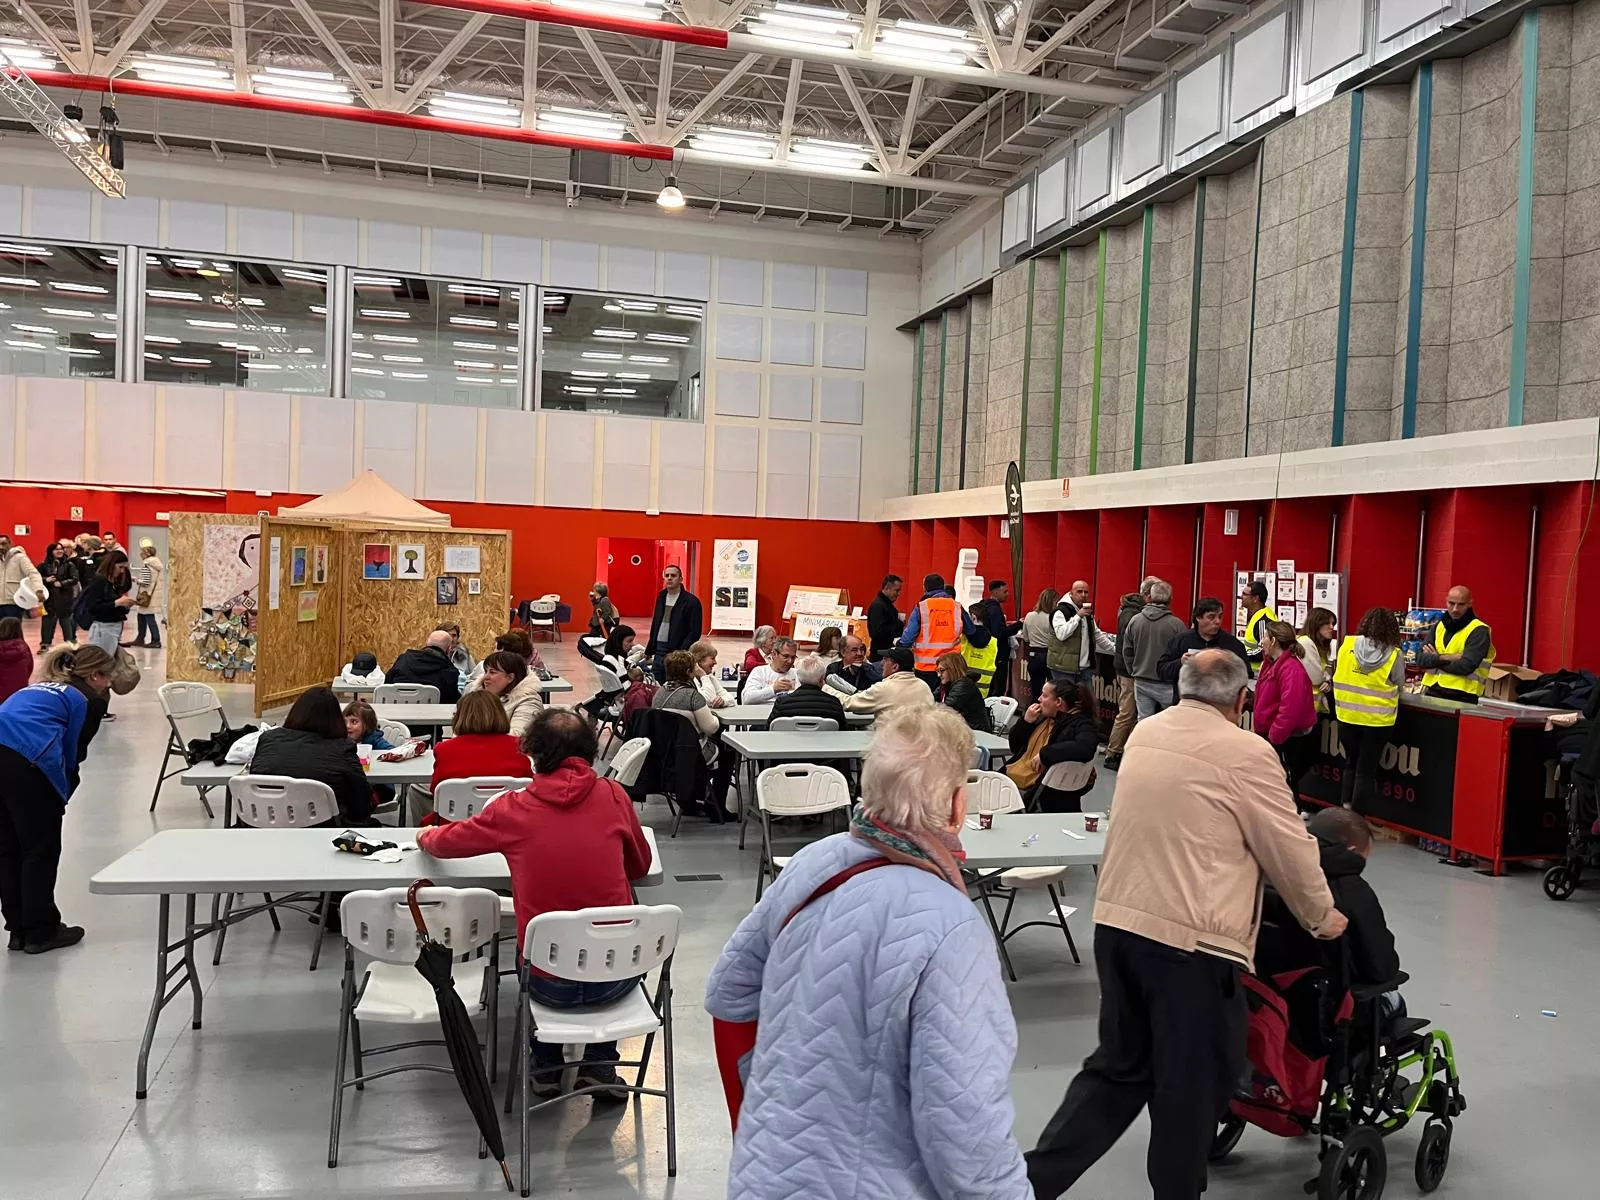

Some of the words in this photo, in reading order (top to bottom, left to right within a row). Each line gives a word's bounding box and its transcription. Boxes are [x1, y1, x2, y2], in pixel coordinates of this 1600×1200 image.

[1091, 674, 1122, 705] Mah
[1309, 763, 1341, 783] DES
[1372, 778, 1416, 803] 1890
